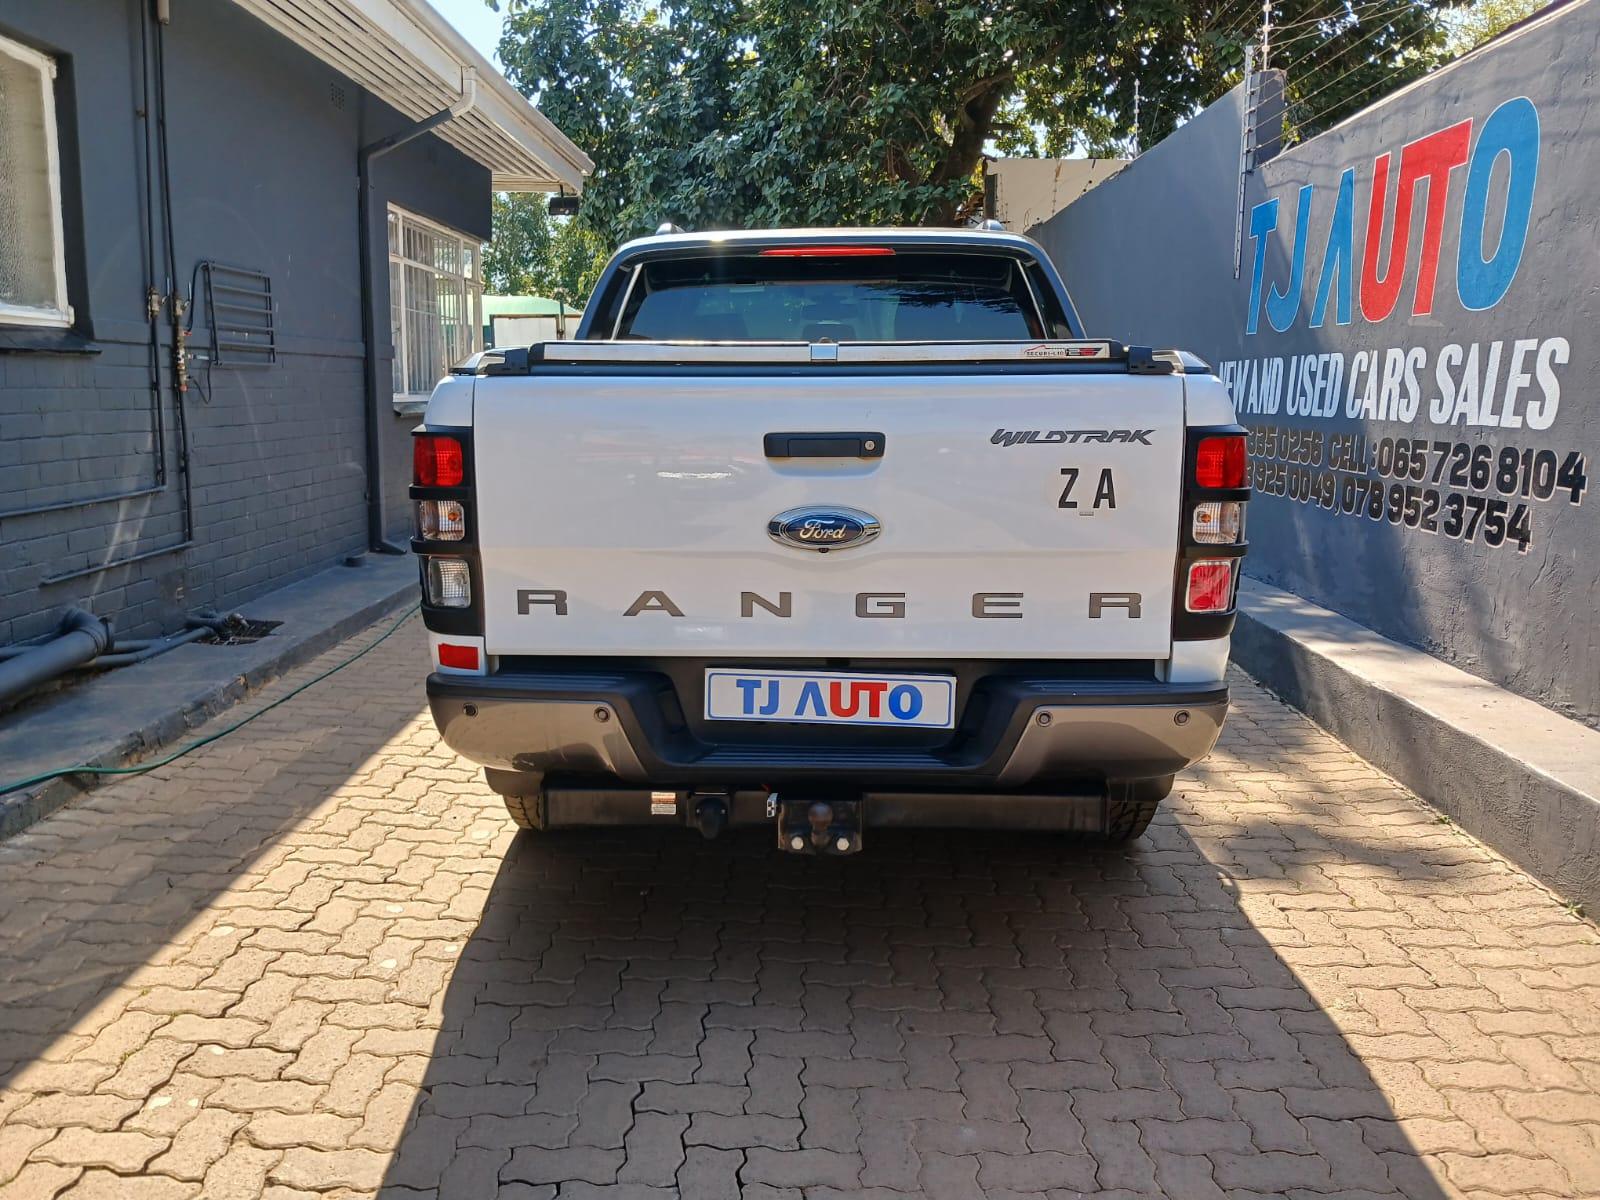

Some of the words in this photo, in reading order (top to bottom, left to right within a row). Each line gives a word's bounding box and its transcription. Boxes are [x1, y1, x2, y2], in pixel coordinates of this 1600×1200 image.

[1246, 184, 1313, 334] TJ
[1309, 96, 1540, 328] AUTO
[1246, 356, 1284, 414] AND
[1286, 352, 1343, 417] USED
[1346, 346, 1426, 423] CARS
[1430, 337, 1570, 431] SALES
[990, 428, 1156, 447] WILDTRAK
[799, 519, 846, 539] Ford
[517, 589, 1142, 618] RANGER
[736, 679, 780, 715] TJ
[794, 681, 923, 720] AUTO
